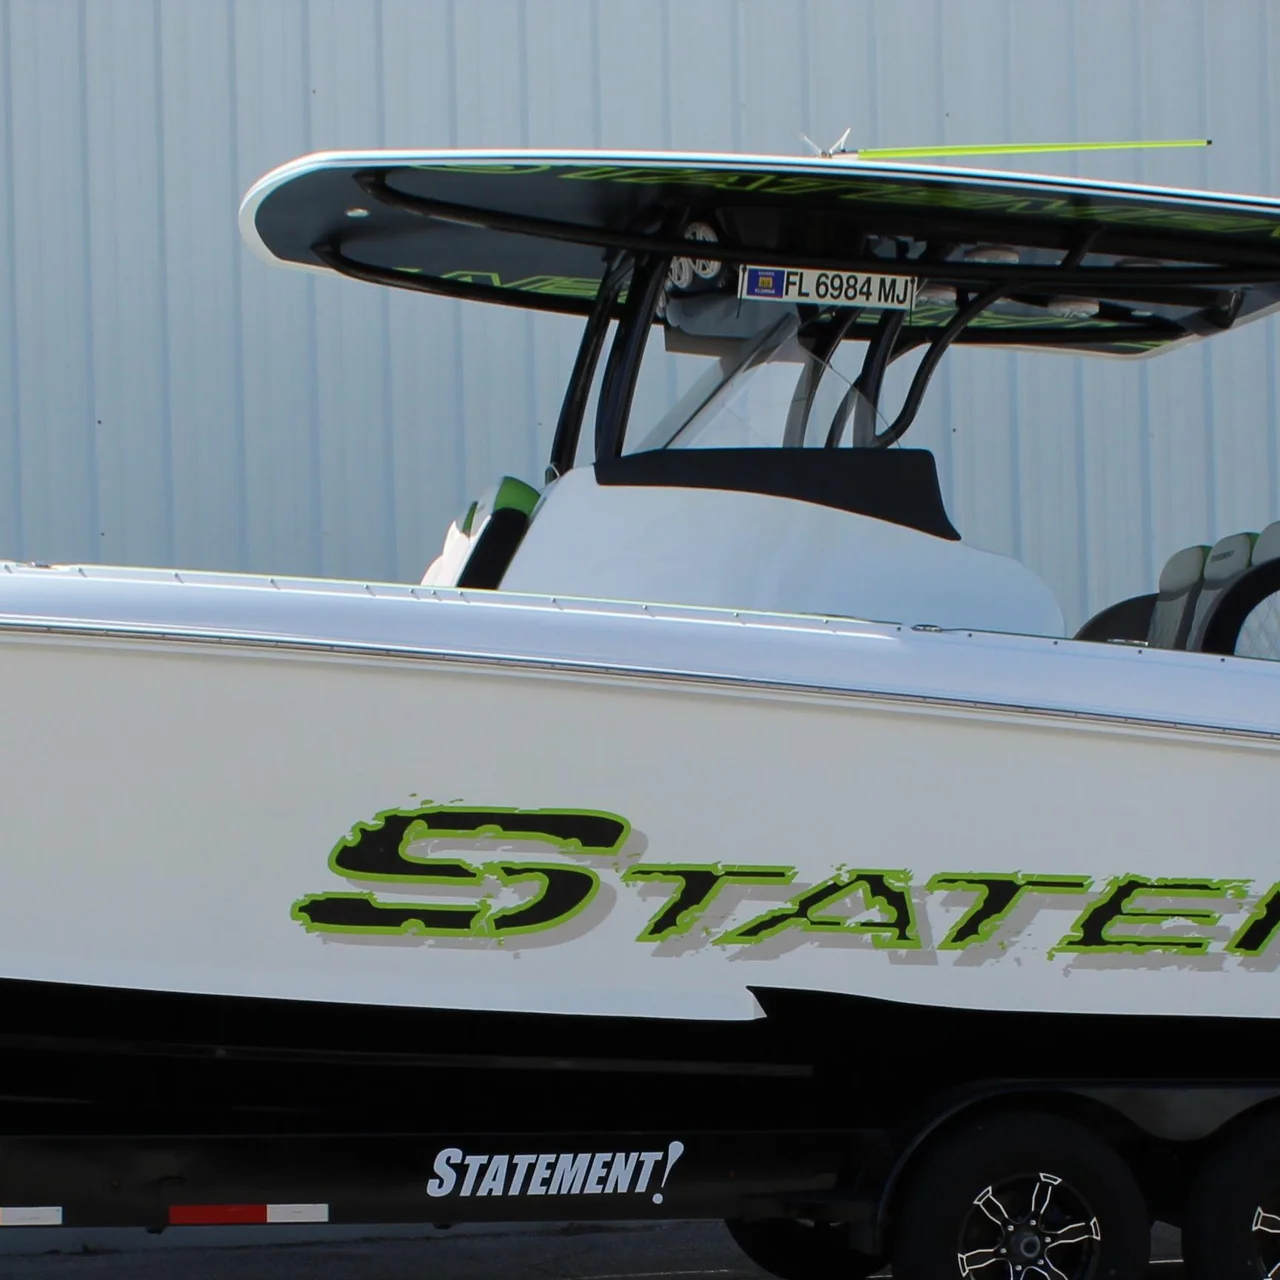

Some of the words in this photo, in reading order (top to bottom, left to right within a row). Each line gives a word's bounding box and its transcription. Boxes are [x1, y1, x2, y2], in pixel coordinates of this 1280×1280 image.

[784, 271, 810, 298] FL
[815, 273, 873, 302] 6984
[877, 277, 909, 305] MJ
